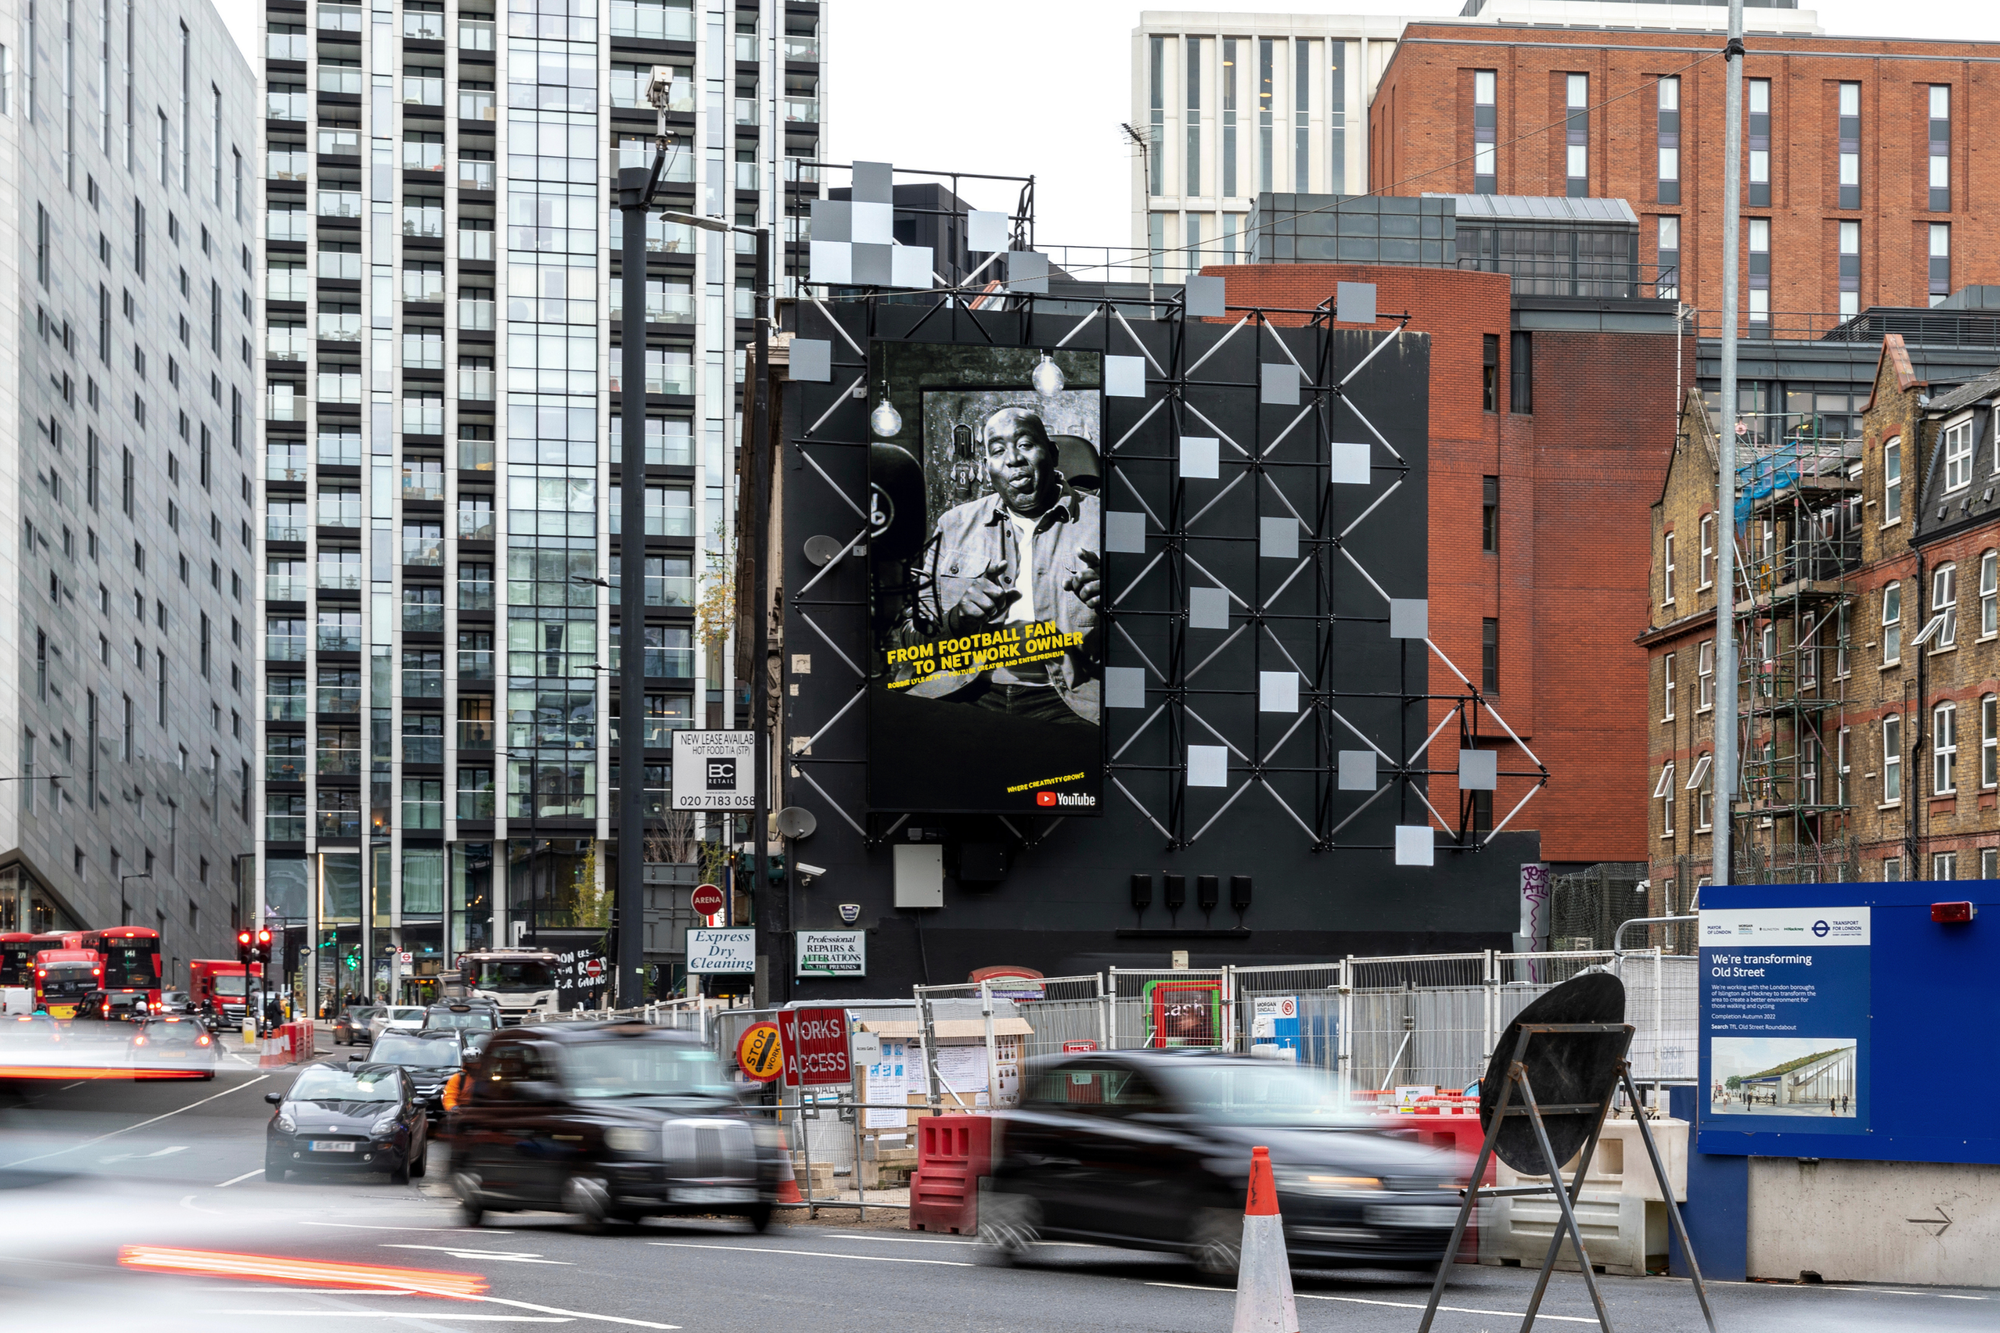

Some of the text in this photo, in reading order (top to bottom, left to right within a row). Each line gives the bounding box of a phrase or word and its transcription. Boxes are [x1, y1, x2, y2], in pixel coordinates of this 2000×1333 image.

[887, 621, 1056, 665] FROM FOOTBALL FAN
[913, 632, 1084, 674] TO NETWORK OWNER
[911, 676, 925, 685] LYLE
[948, 667, 976, 678] YOUTUBE
[977, 661, 1004, 671] CREATOR
[1019, 651, 1065, 664] ENTREPRENEUR
[681, 734, 699, 745] NEW
[702, 734, 722, 744] LEASE
[692, 746, 705, 754] HOT
[707, 746, 724, 754] FOOD
[737, 746, 750, 757] (STP)
[709, 764, 734, 777] BC
[1007, 772, 1085, 793] WHERE CREATIVITY GROWS
[680, 796, 701, 806] 020
[705, 796, 731, 806] 7183
[1057, 793, 1096, 806] YouTube
[695, 931, 751, 944] Express
[807, 935, 856, 943] Professional
[708, 945, 735, 959] Dry
[691, 957, 754, 971] Cleaning
[1712, 954, 1812, 966] We're transforming
[1712, 967, 1765, 977] Old Street
[785, 1019, 840, 1041] WORKS
[747, 1030, 766, 1066] STOP
[789, 1052, 846, 1074] ACCESS
